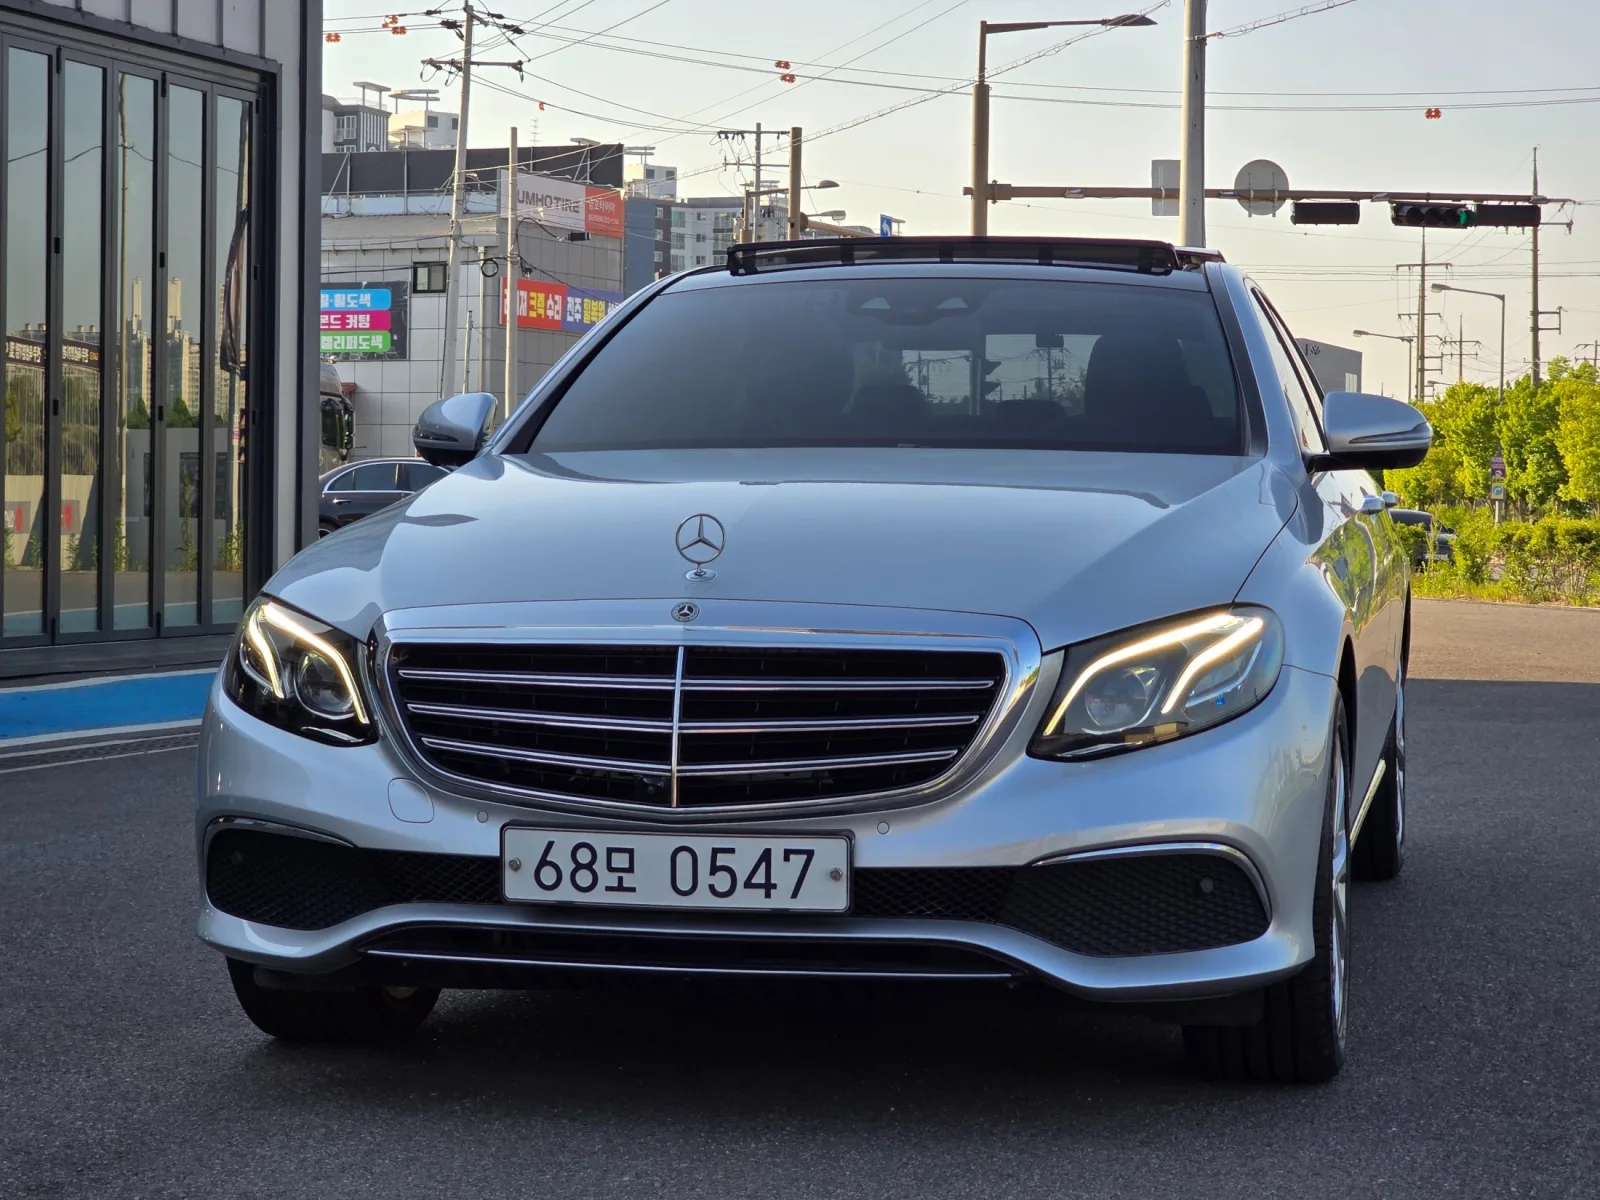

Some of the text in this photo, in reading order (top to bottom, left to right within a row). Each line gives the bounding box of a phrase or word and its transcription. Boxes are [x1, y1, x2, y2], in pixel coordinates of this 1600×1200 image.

[516, 189, 553, 209] UMHO
[547, 293, 562, 321] 수리
[566, 296, 582, 323] 전주
[345, 314, 370, 329] 커팅
[533, 839, 815, 899] 68모 0547
